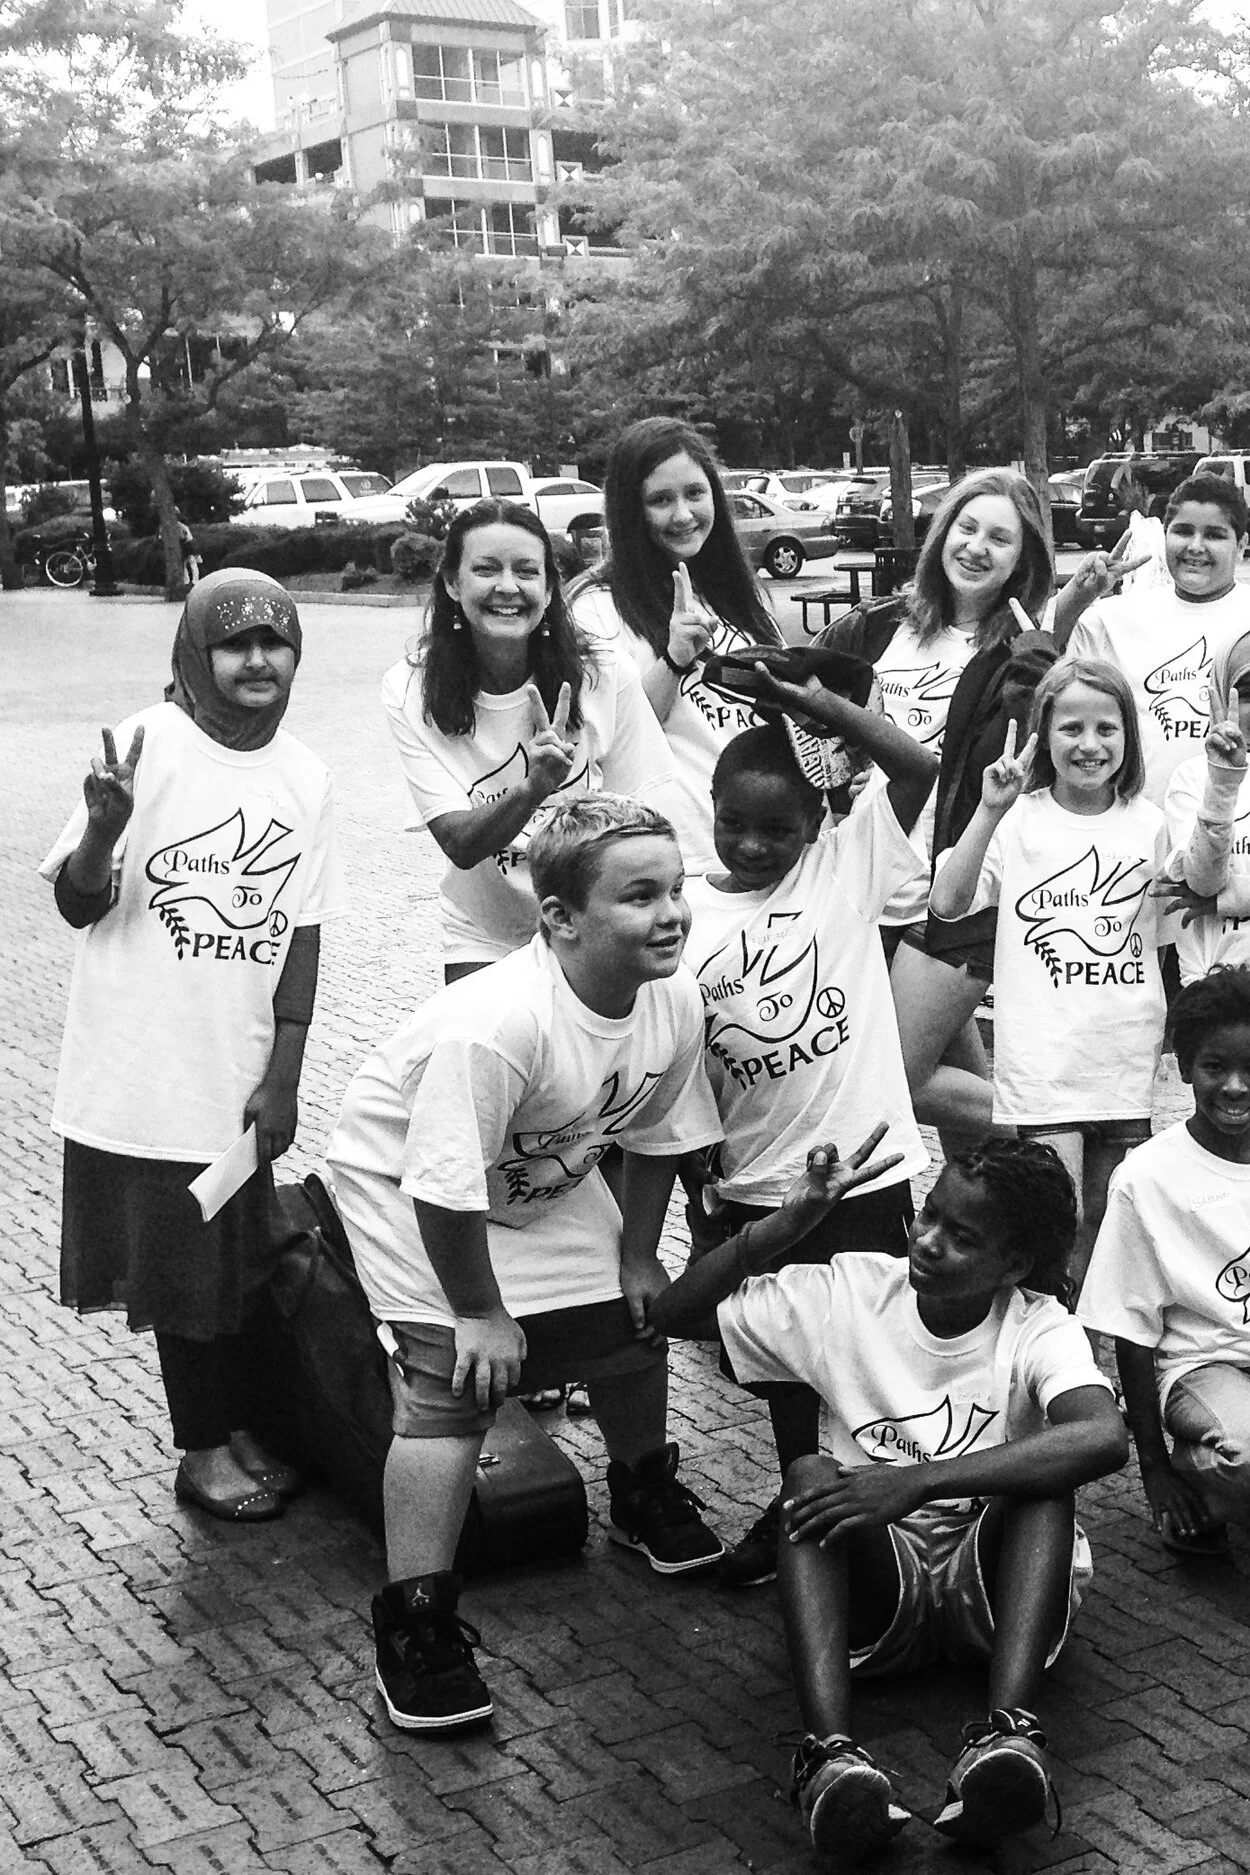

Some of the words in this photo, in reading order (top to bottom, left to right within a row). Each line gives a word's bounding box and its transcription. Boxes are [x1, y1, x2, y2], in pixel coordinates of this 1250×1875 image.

[1155, 666, 1197, 689] Paths
[907, 707, 932, 727] To
[163, 850, 230, 876] Paths
[232, 886, 263, 908] To
[1031, 889, 1089, 915] Paths
[1094, 916, 1122, 937] To
[192, 933, 281, 965] PEACE
[1065, 961, 1145, 985] PEACE
[757, 991, 793, 1022] To
[741, 1015, 850, 1086] PEACE
[871, 1424, 931, 1463] Paths
